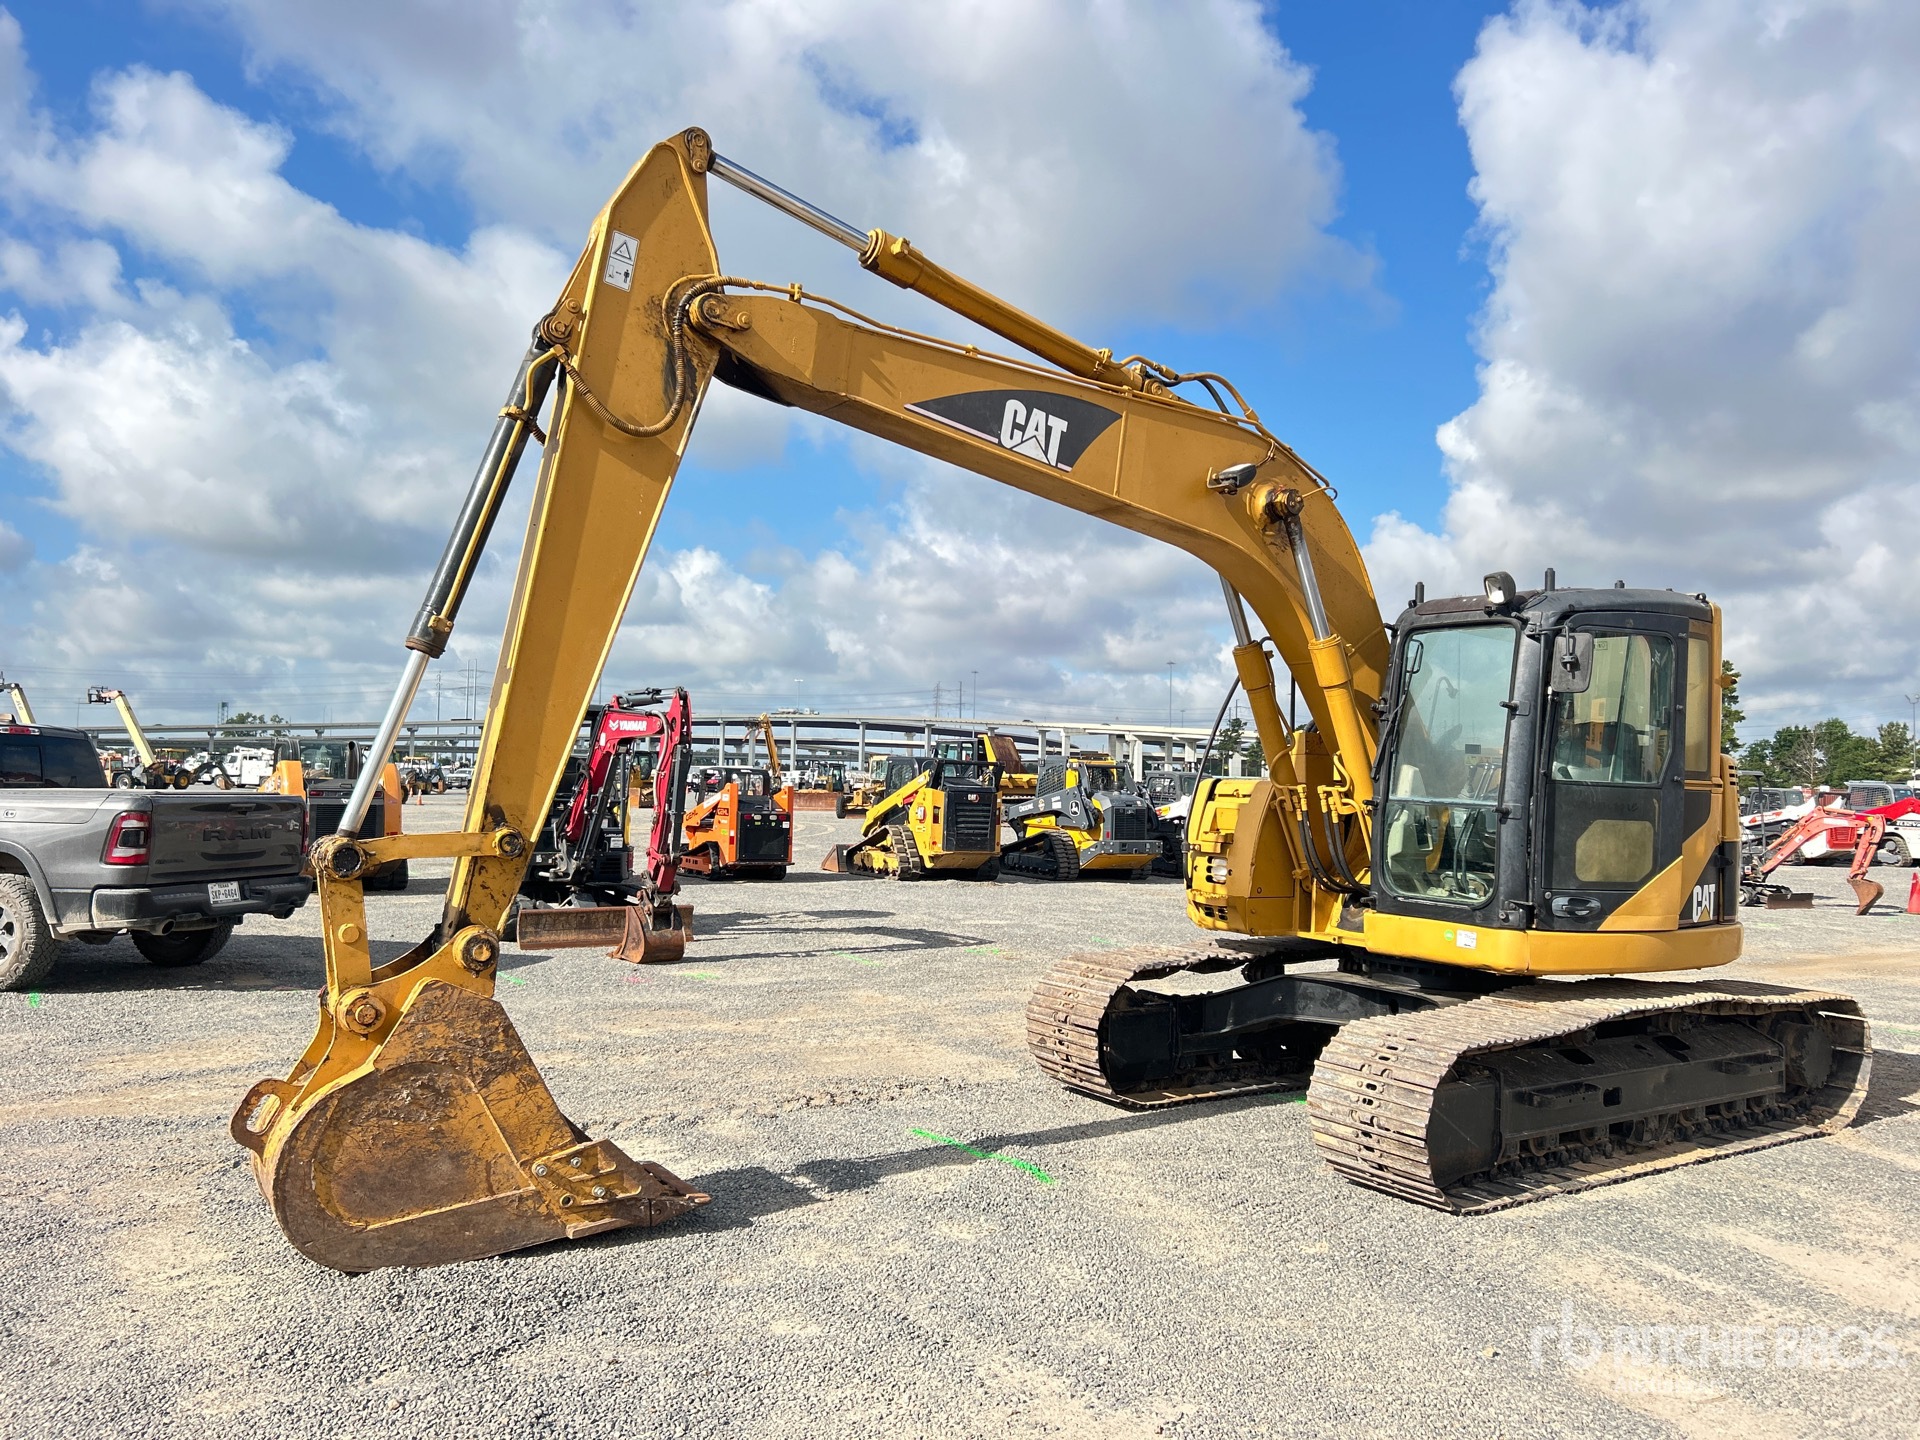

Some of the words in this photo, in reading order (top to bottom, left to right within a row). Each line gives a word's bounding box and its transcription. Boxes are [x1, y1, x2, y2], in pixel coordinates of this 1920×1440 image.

[1000, 399, 1068, 466] CAT
[620, 720, 648, 731] YANMAR
[203, 828, 272, 841] RAM
[1693, 884, 1716, 923] CAT
